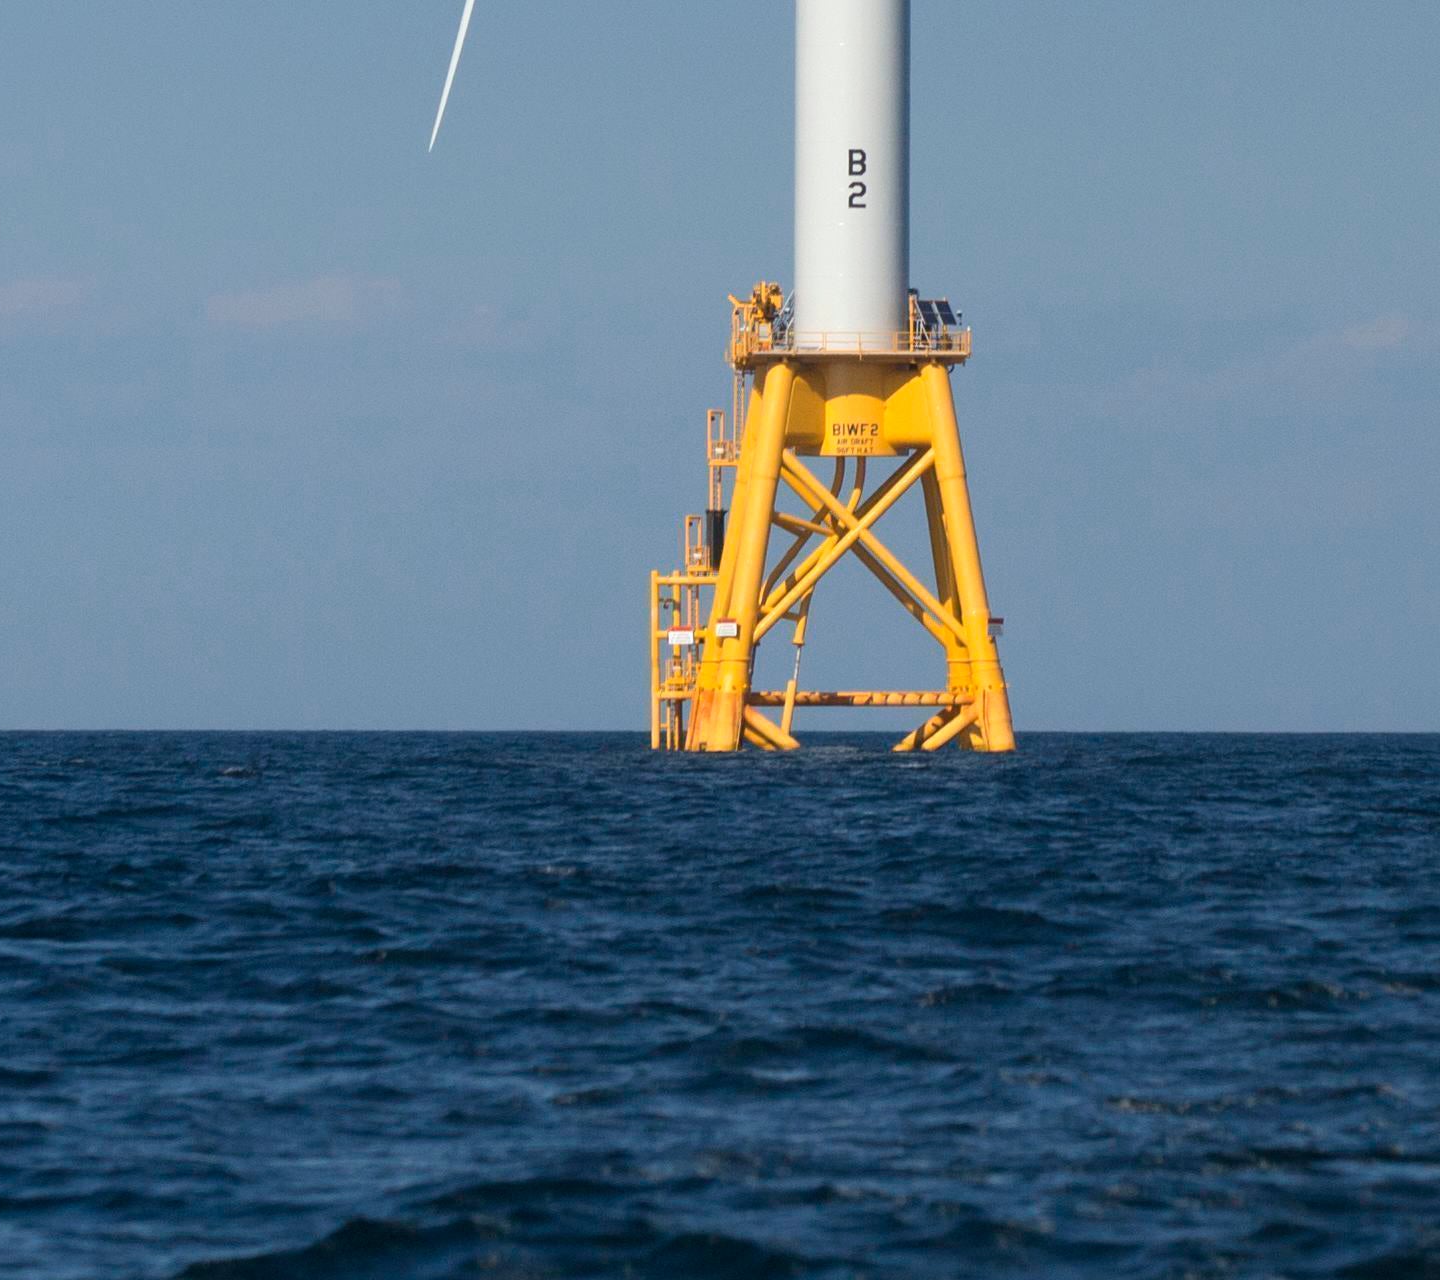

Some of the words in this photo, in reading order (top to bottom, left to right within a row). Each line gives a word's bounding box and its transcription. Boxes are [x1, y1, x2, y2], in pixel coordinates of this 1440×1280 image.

[848, 149, 866, 176] B
[848, 182, 866, 208] 2
[832, 423, 879, 436] BIWF2
